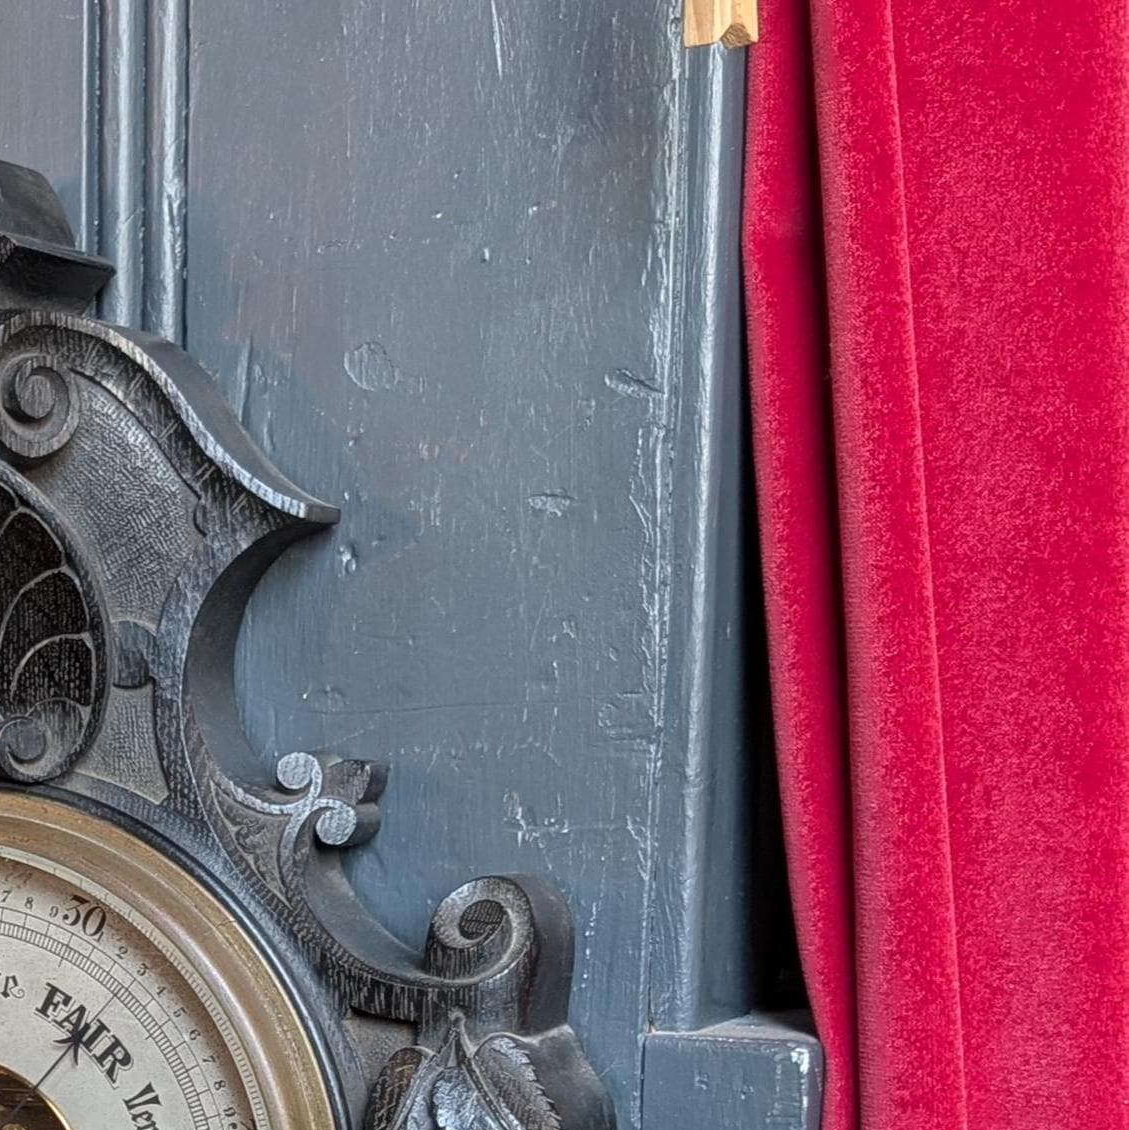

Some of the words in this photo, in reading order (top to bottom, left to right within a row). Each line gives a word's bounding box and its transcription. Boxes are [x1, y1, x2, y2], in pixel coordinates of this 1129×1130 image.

[0, 889, 12, 903] 7
[24, 896, 33, 910] 8
[49, 905, 59, 918] 9
[62, 894, 107, 937] 30
[115, 945, 128, 960] 2
[137, 962, 149, 976] 3
[173, 1006, 188, 1018] 5
[189, 1028, 201, 1041] 6
[202, 1055, 216, 1063] 7
[214, 1080, 226, 1091] 8
[33, 981, 134, 1089] FAIR
